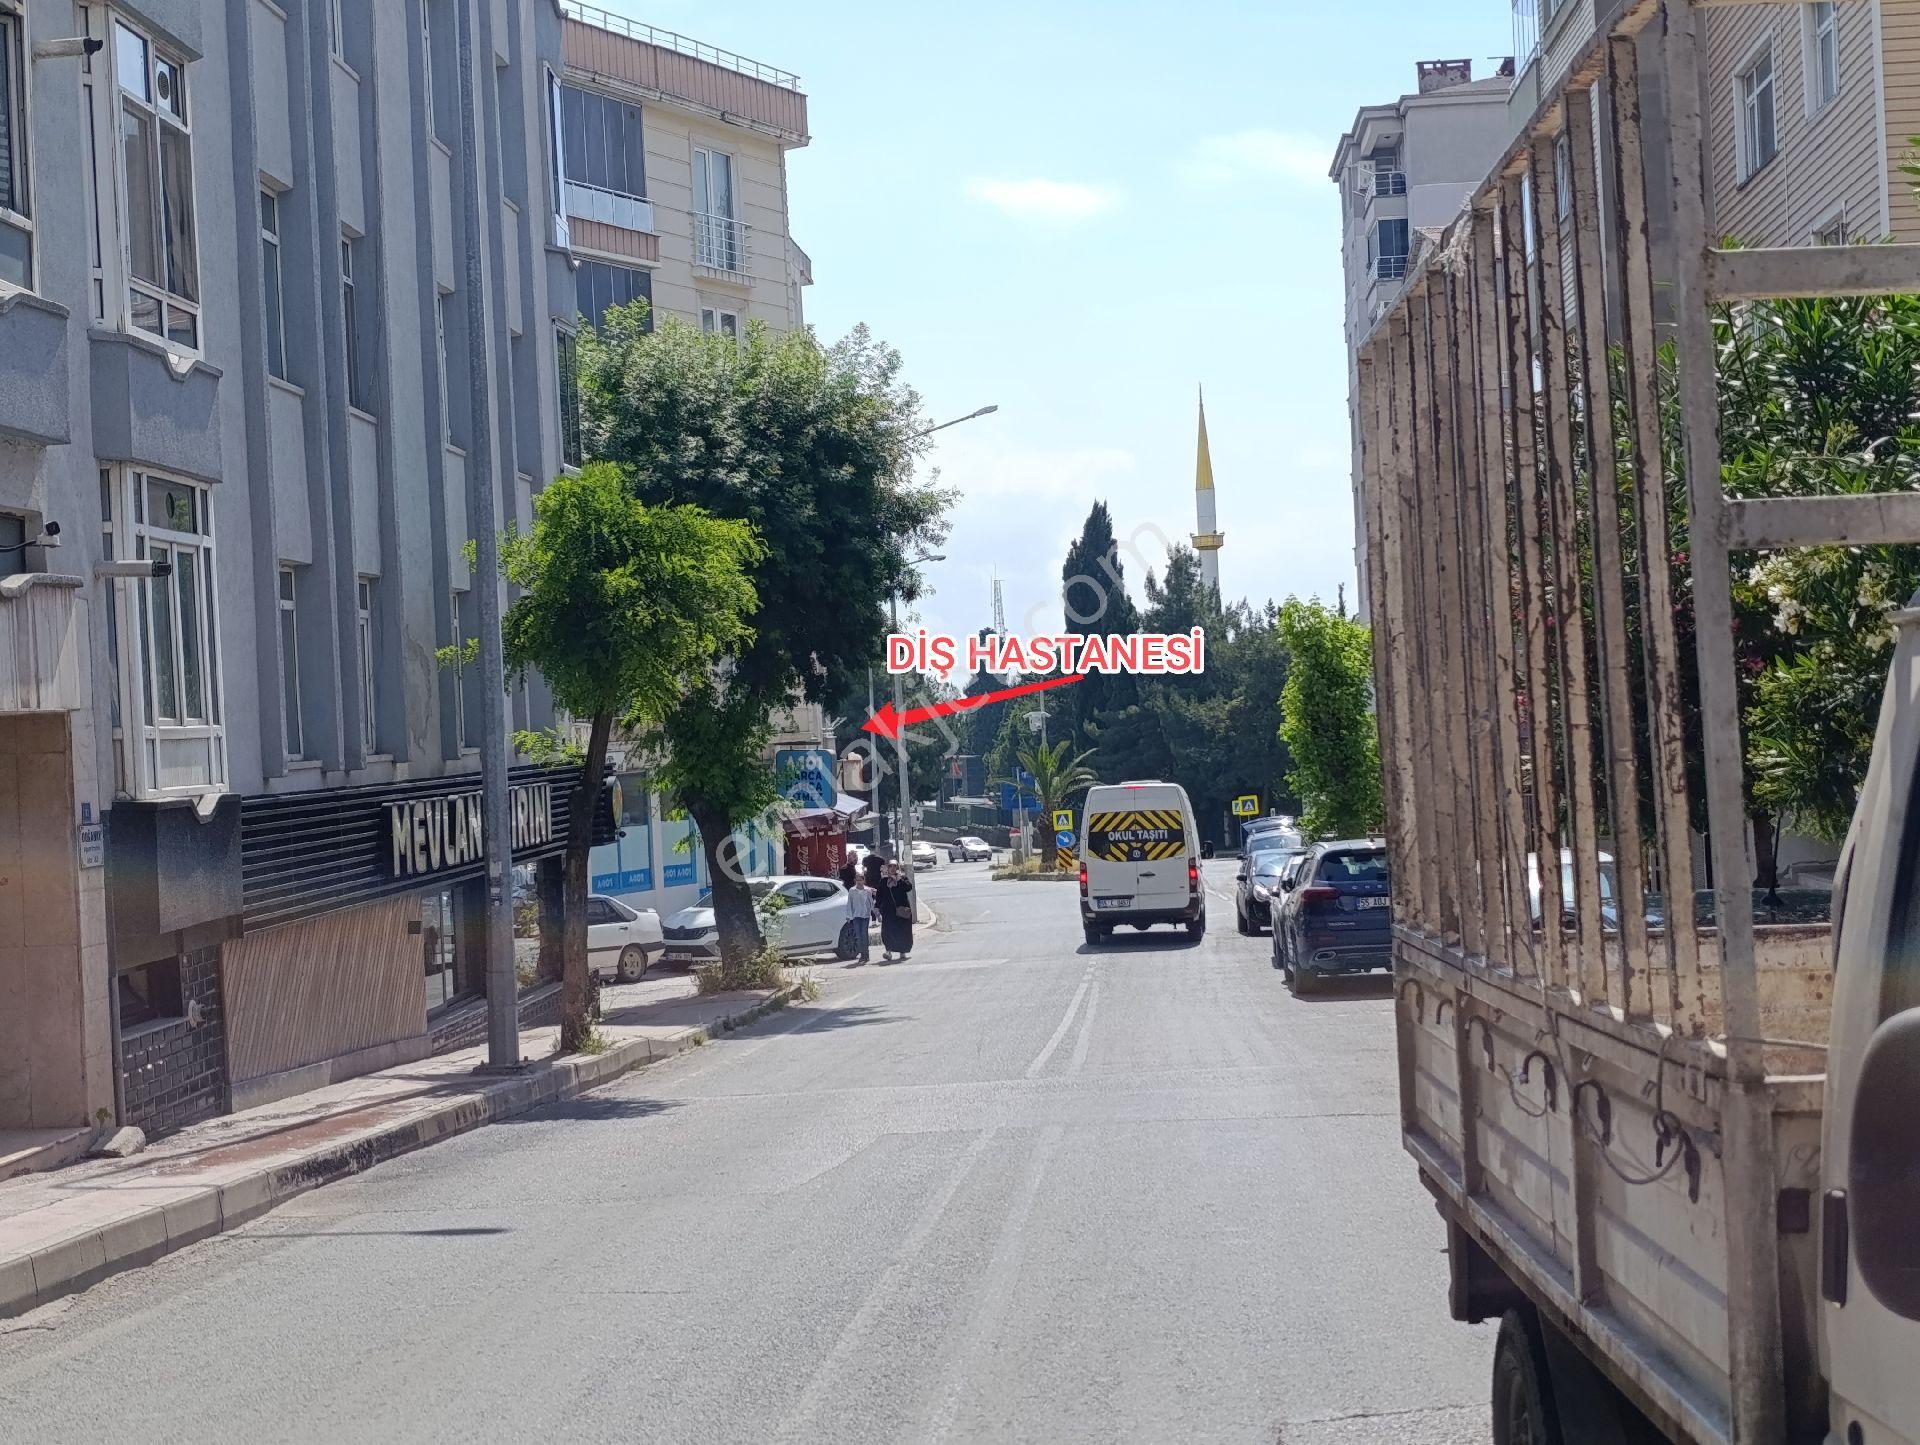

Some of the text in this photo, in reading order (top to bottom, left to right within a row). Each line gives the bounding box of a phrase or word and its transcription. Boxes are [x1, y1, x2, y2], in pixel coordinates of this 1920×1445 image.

[788, 771, 822, 780] ARCA
[390, 783, 553, 877] MEVLAN IRINI
[1108, 830, 1168, 841] OKUL TAŞITI
